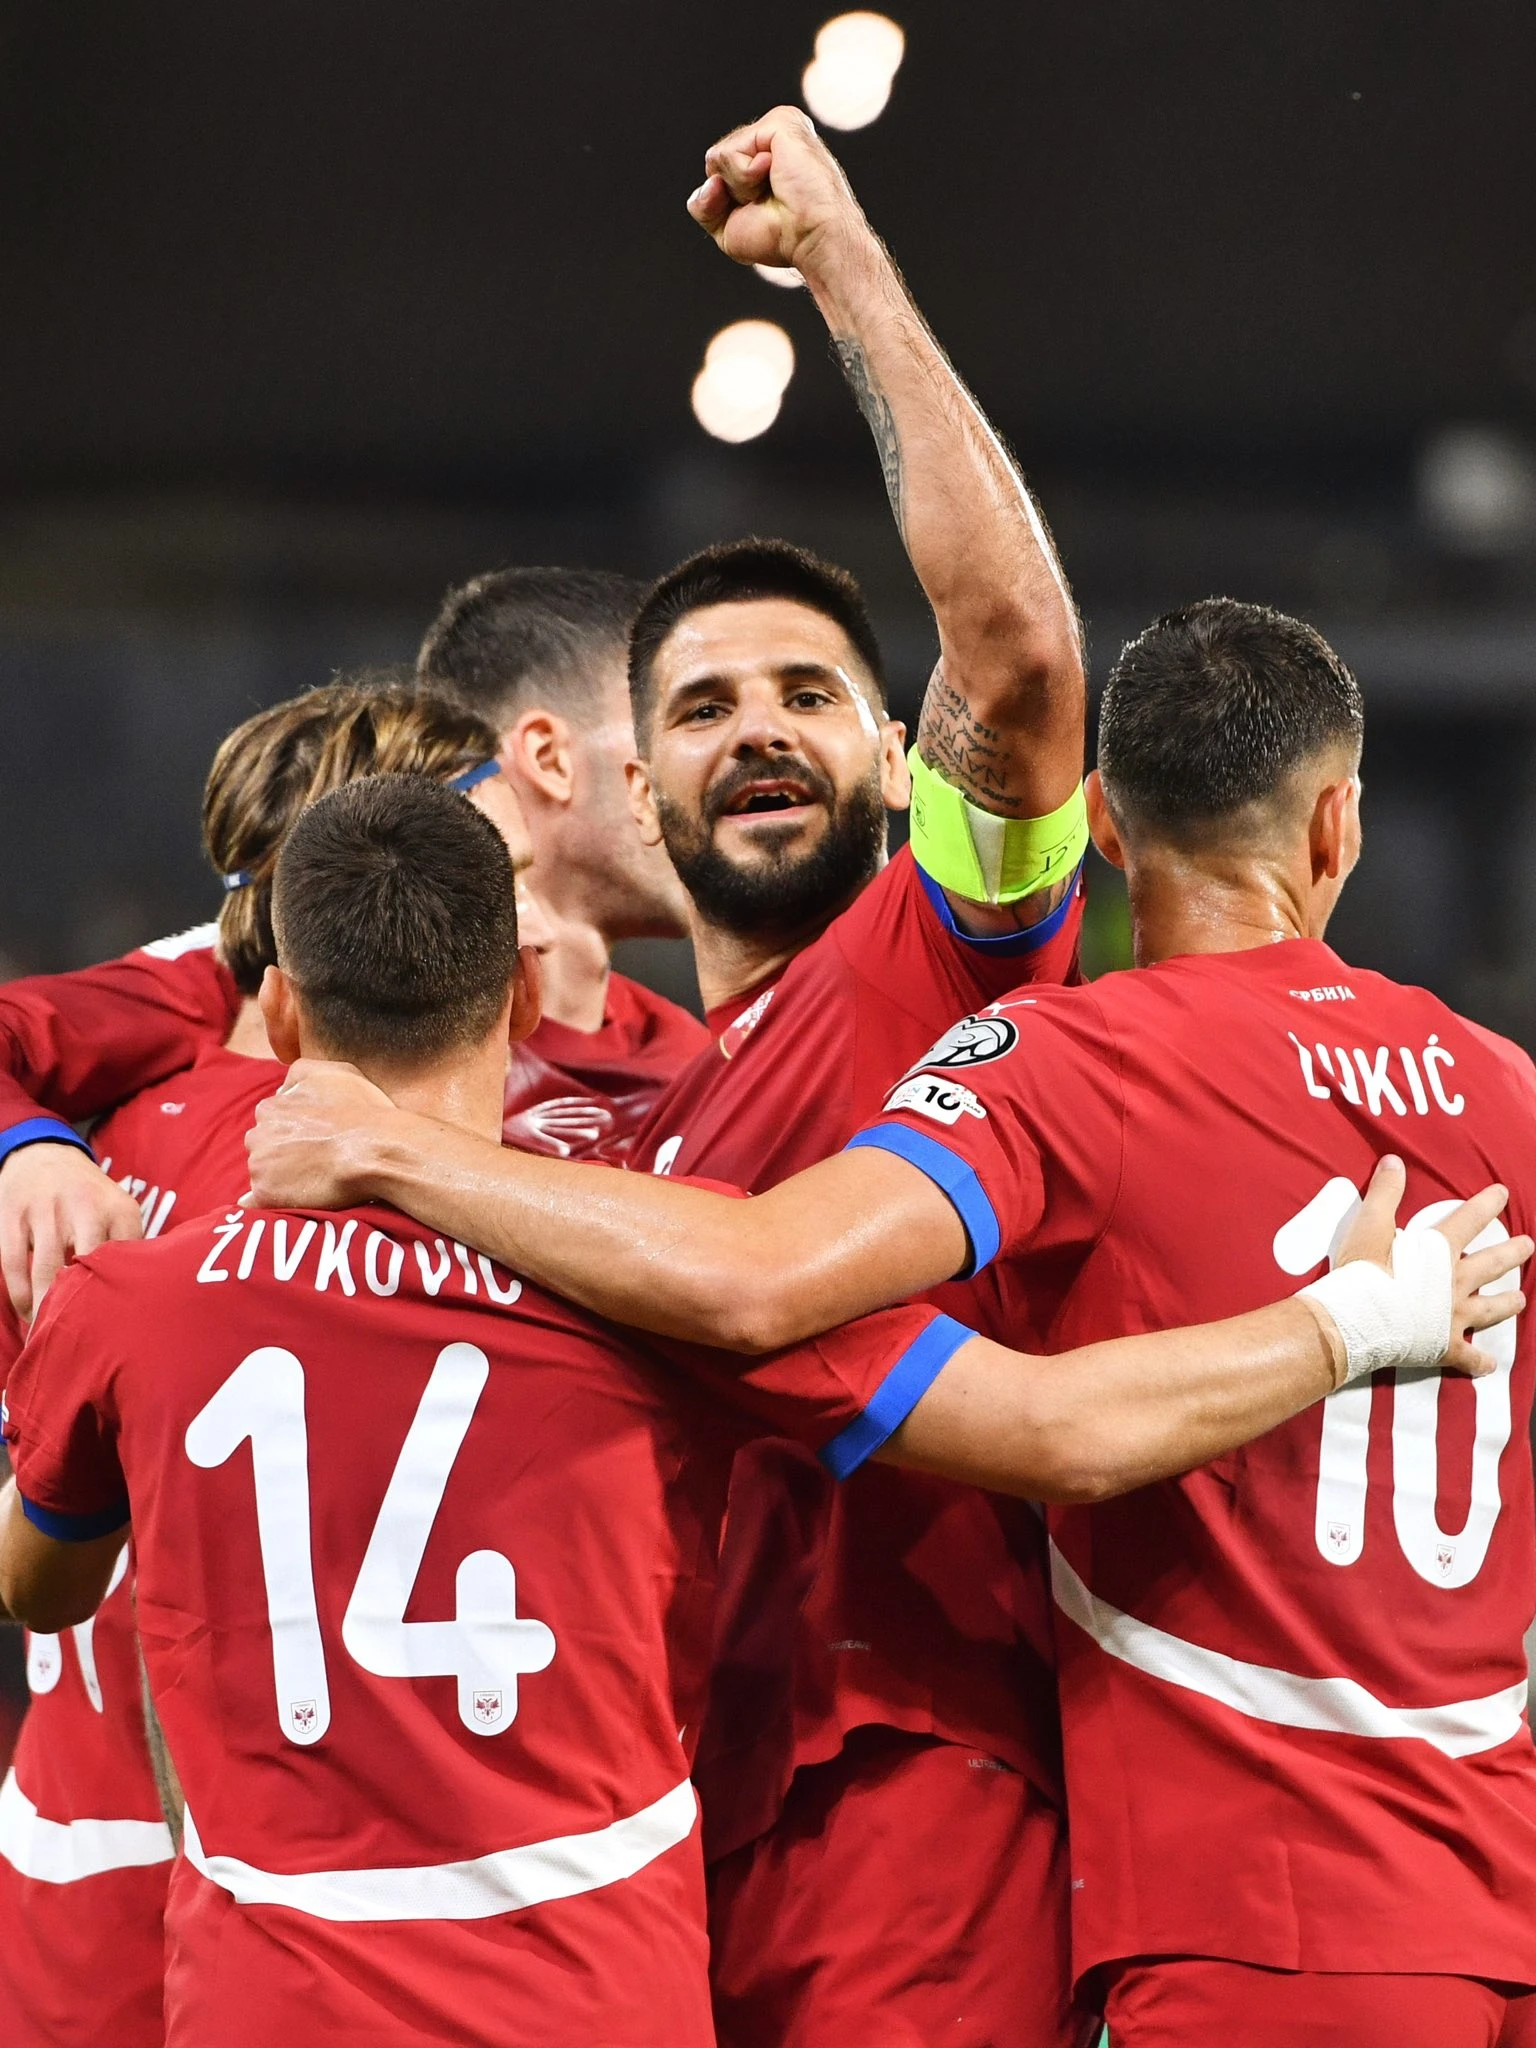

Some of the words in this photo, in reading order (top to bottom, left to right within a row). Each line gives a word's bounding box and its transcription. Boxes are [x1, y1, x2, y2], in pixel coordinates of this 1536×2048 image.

[924, 1085, 961, 1111] 10
[1288, 1031, 1465, 1116] LUKIĆ
[1273, 1176, 1521, 1590] 10
[184, 1341, 557, 1746] 14
